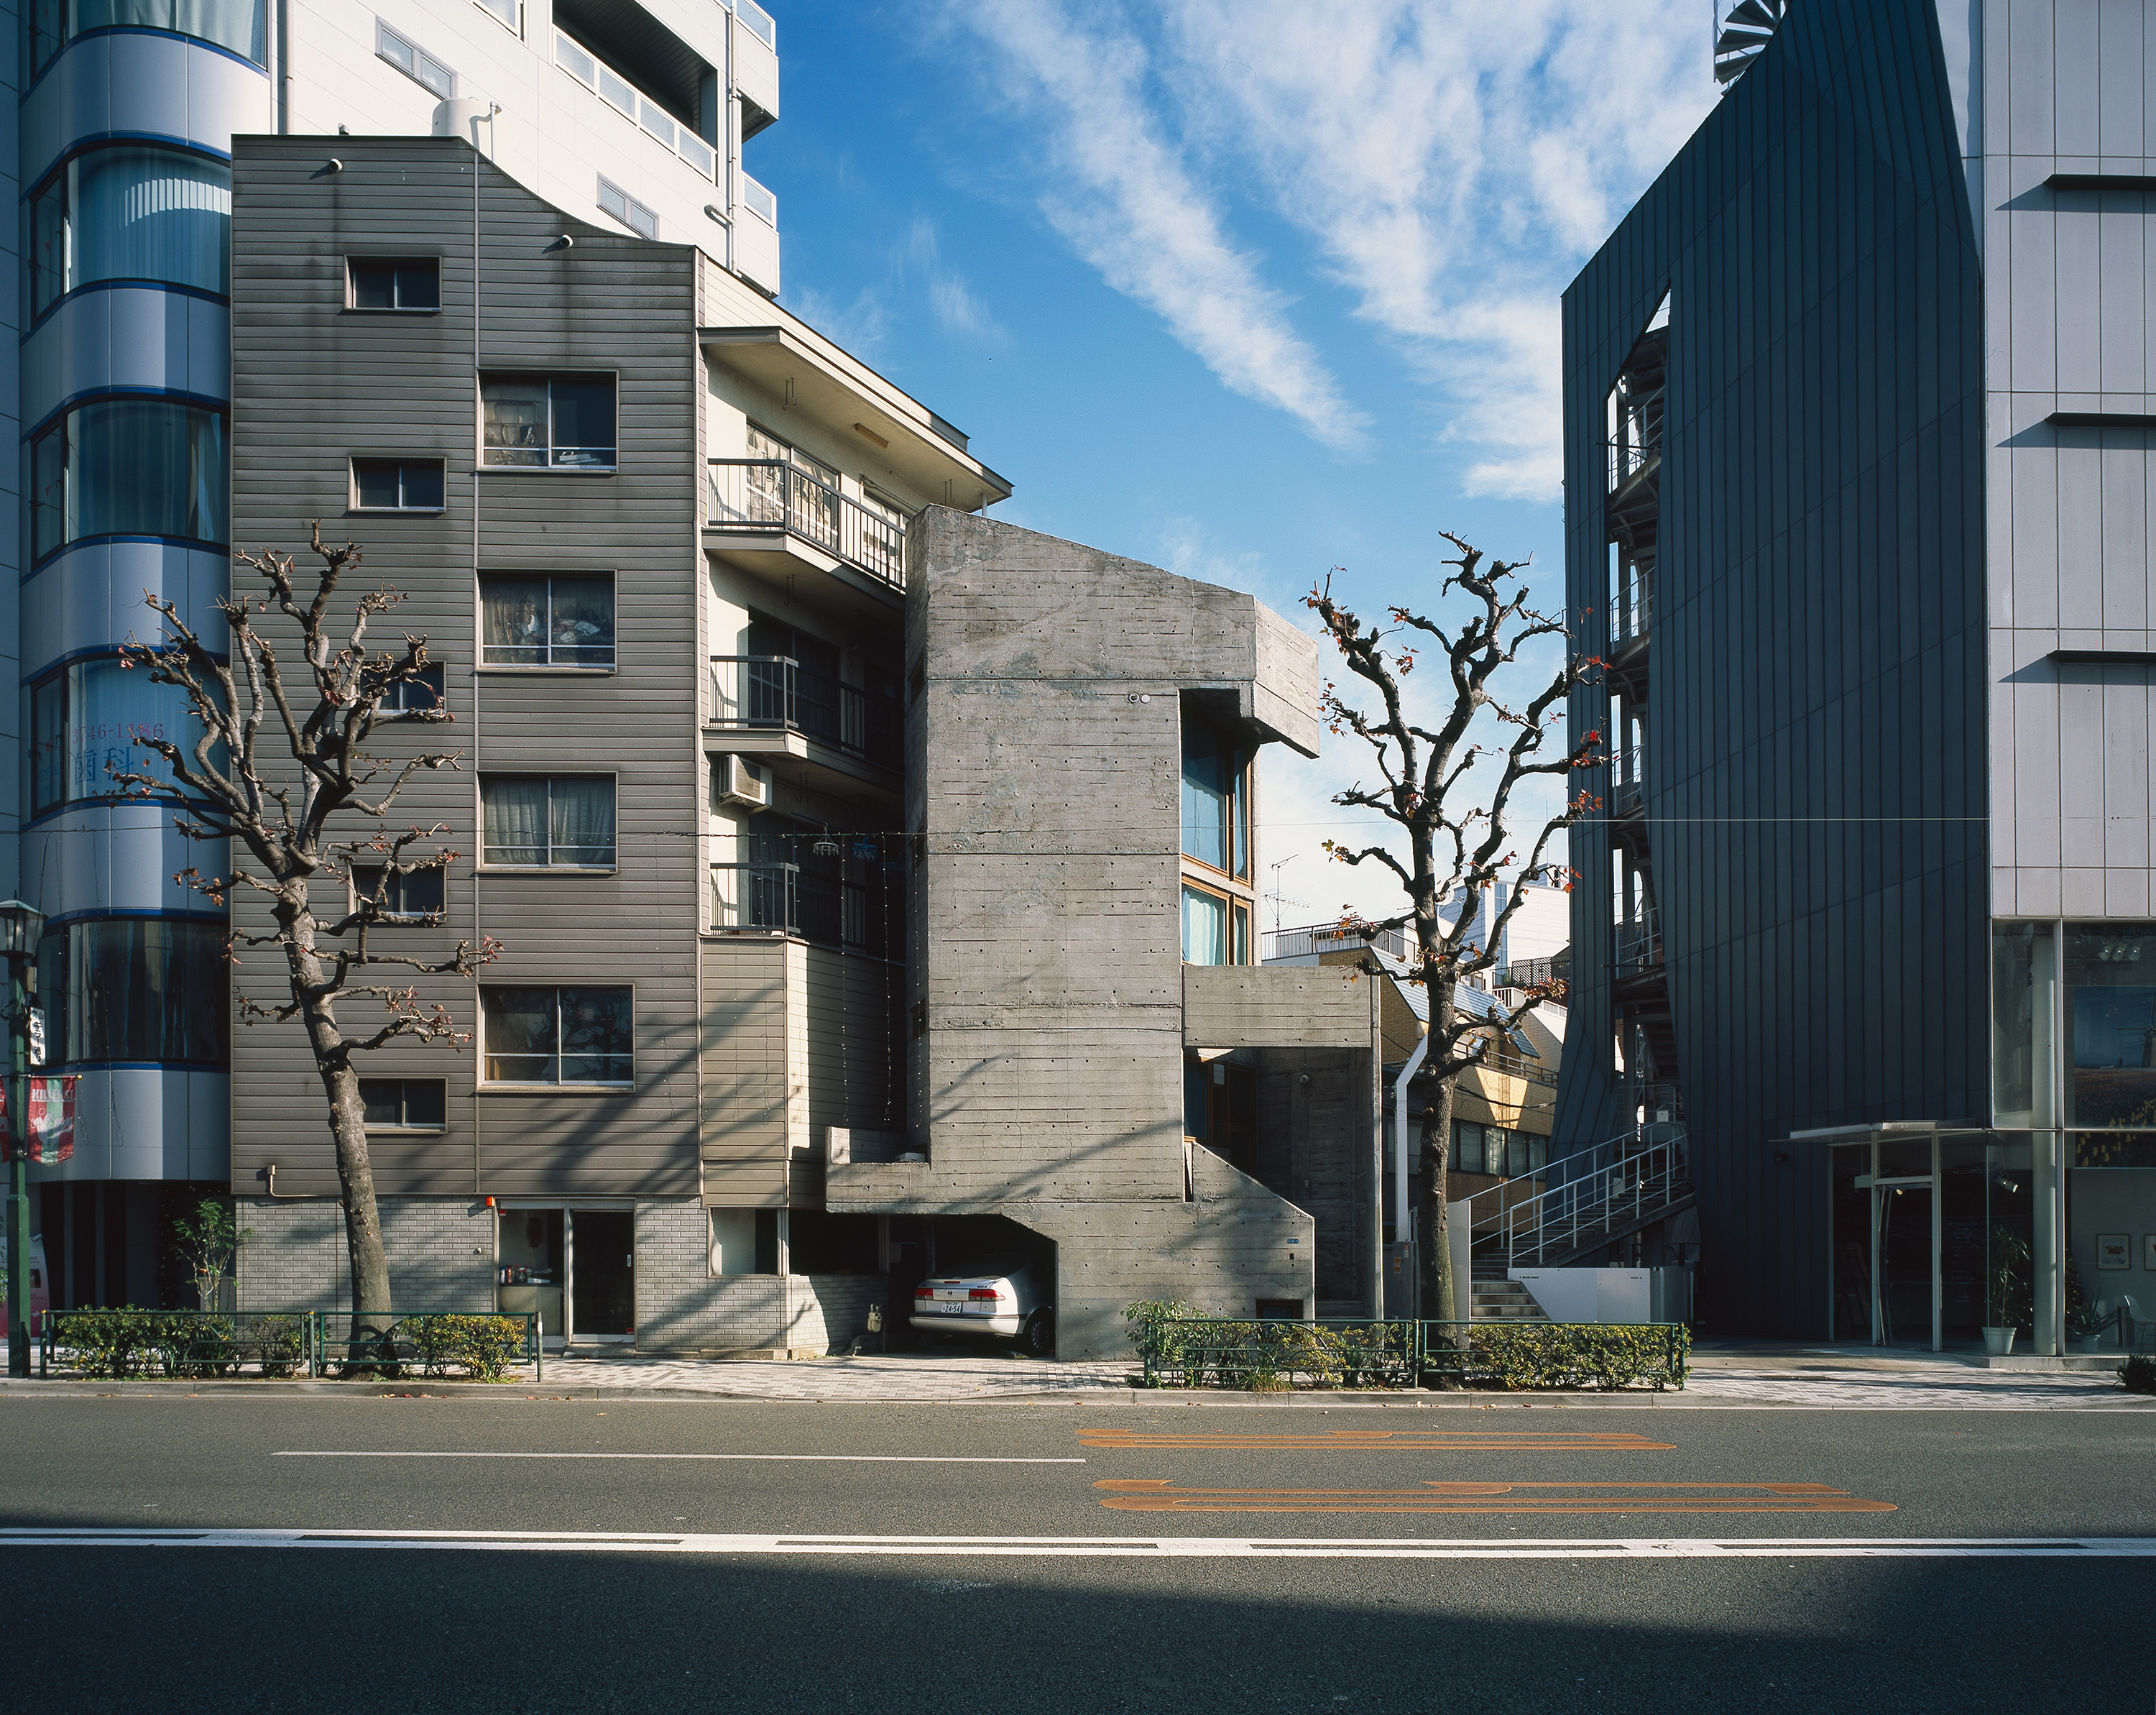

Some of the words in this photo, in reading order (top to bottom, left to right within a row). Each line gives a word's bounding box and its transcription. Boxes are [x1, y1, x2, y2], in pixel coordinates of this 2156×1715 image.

[72, 722, 165, 745] 3746-1186
[75, 746, 135, 786] 歯科
[33, 1021, 42, 1062] キラー通り
[32, 1089, 63, 1100] KILLER
